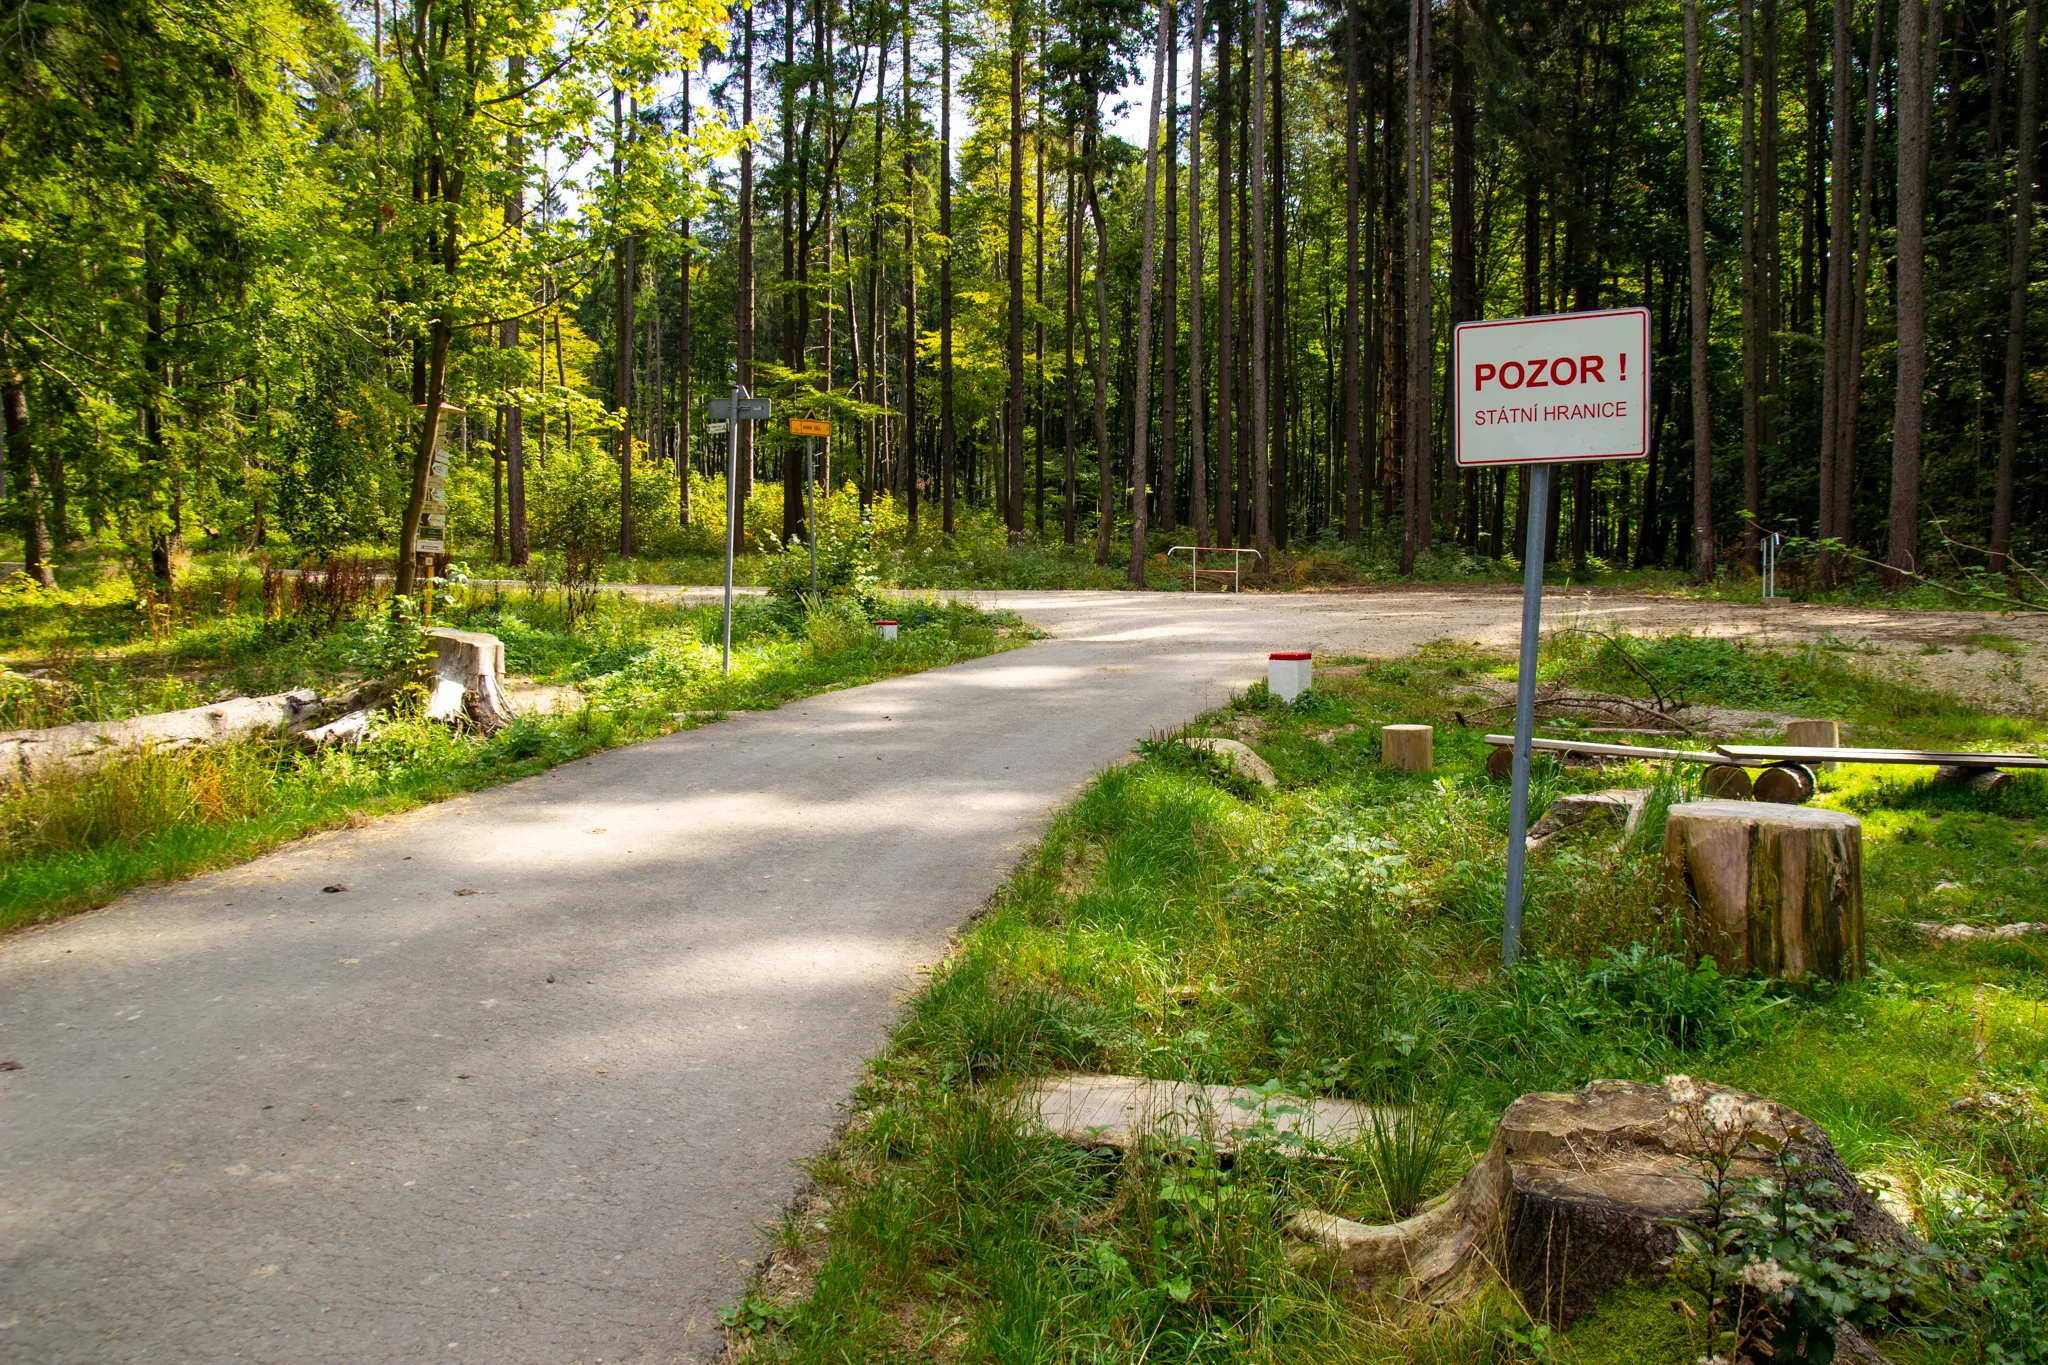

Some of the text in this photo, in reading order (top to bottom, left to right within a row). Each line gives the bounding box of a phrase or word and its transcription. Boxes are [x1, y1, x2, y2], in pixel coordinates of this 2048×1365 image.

[1475, 353, 1626, 392] POZOR !
[1474, 401, 1628, 426] STÁTNÍ HRANICE
